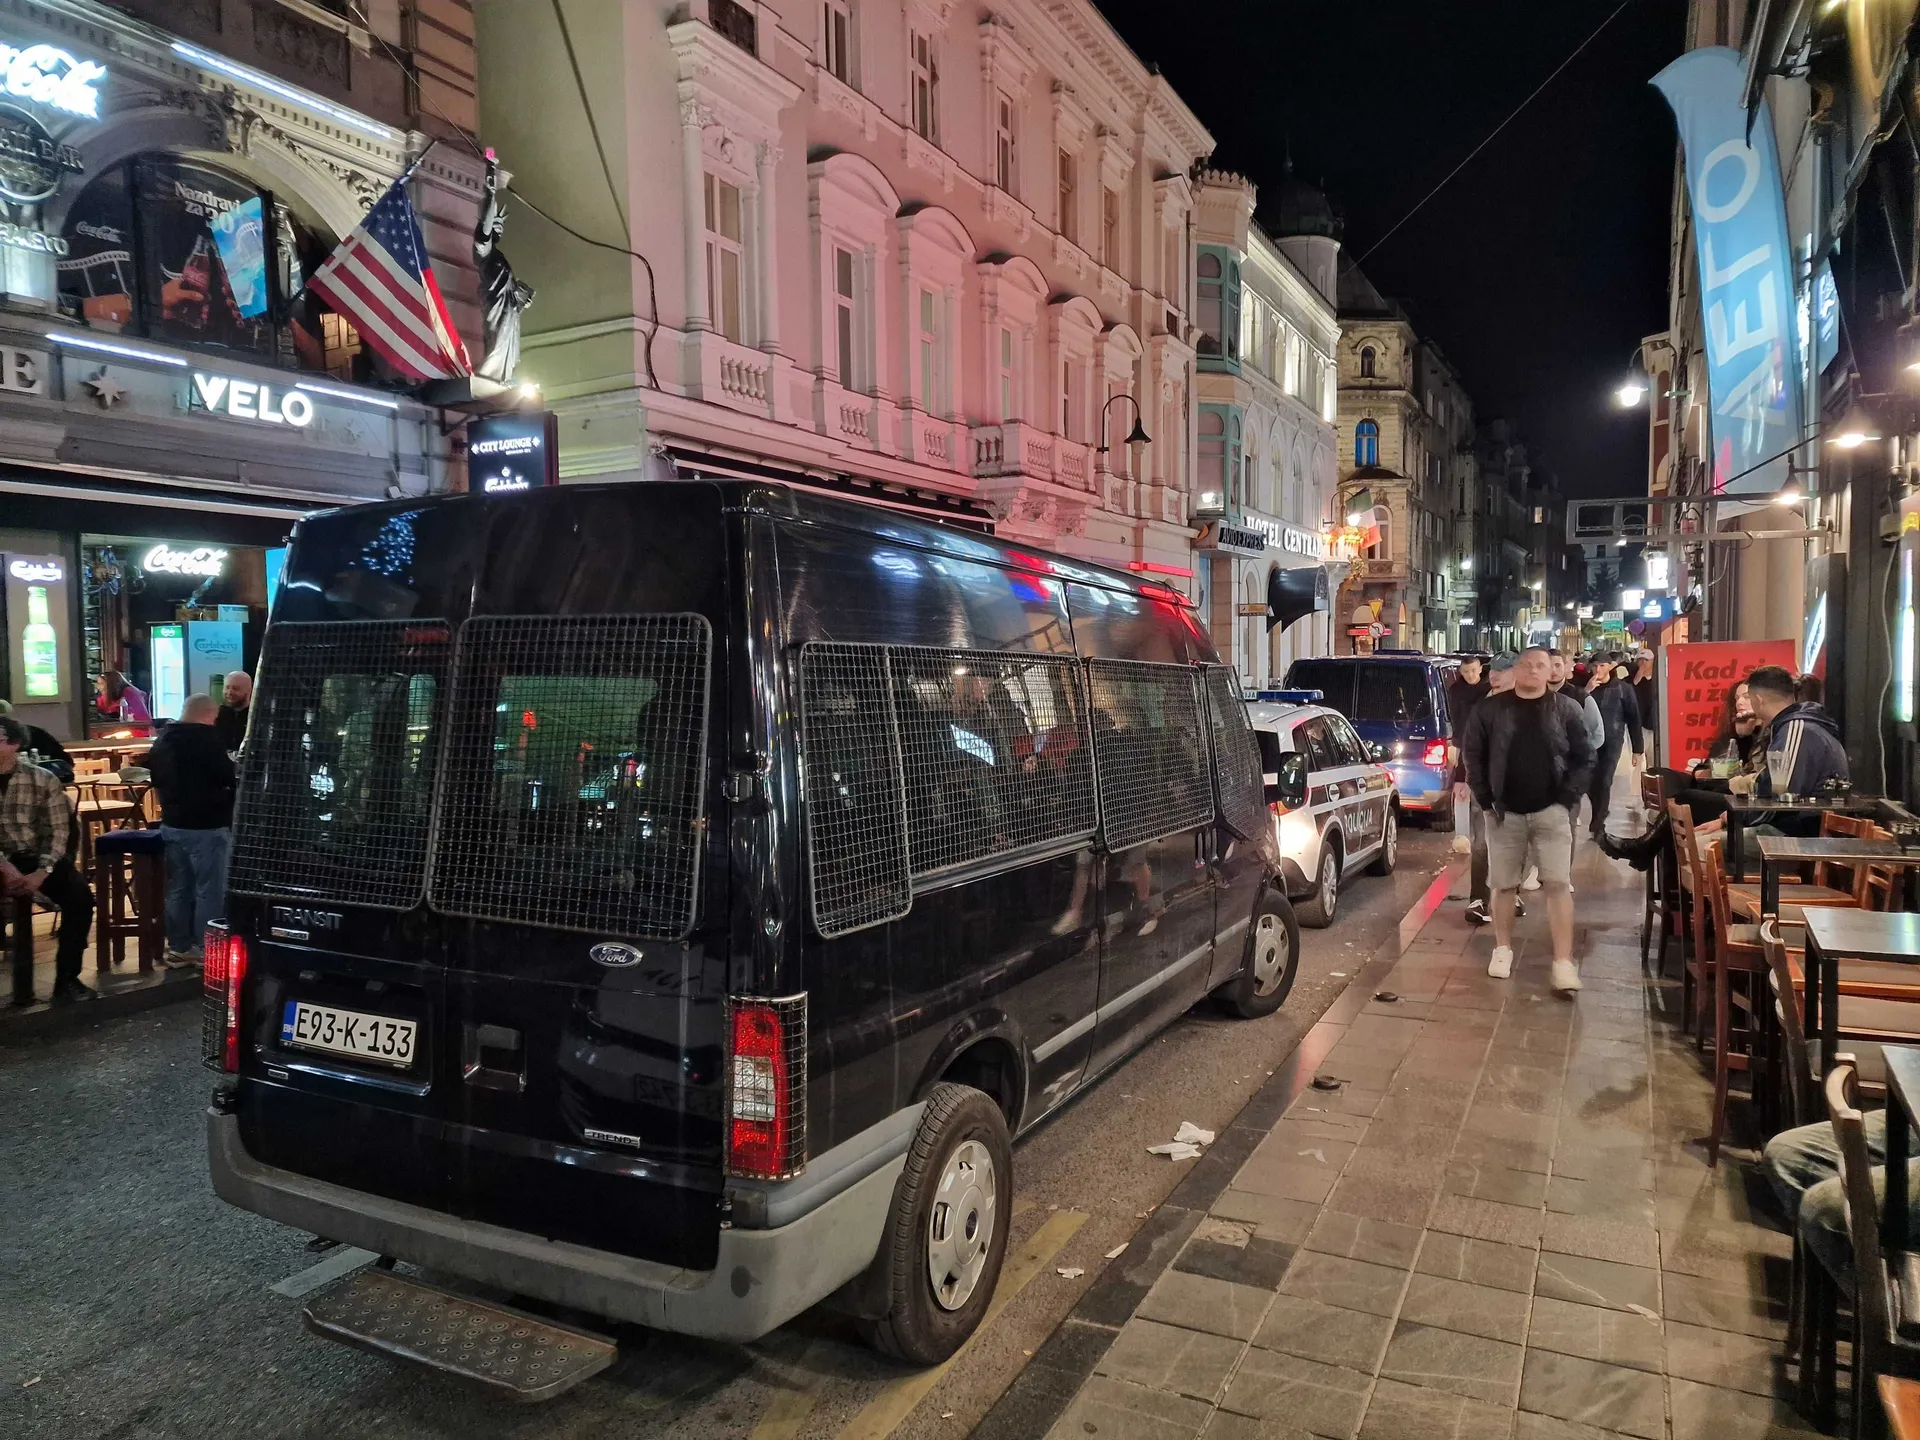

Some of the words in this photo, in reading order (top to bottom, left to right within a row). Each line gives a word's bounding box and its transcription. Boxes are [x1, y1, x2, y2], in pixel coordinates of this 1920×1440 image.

[38, 138, 84, 171] BAR
[175, 181, 241, 214] Nazdravi
[193, 373, 314, 428] VELO
[479, 440, 499, 454] CITY
[499, 437, 533, 451] LOUNGE
[1239, 531, 1265, 552] EXPRESS
[1244, 515, 1282, 548] HOTEL
[1282, 527, 1322, 558] CENTRAL
[194, 638, 238, 653] Carlsberg
[1684, 659, 1738, 681] Kad
[1685, 688, 1701, 702] u
[272, 905, 344, 930] TRANSIT
[598, 945, 628, 964] Ford
[283, 1023, 295, 1035] BH
[295, 1007, 413, 1058] E93-K-133
[590, 1131, 633, 1145] TREND
